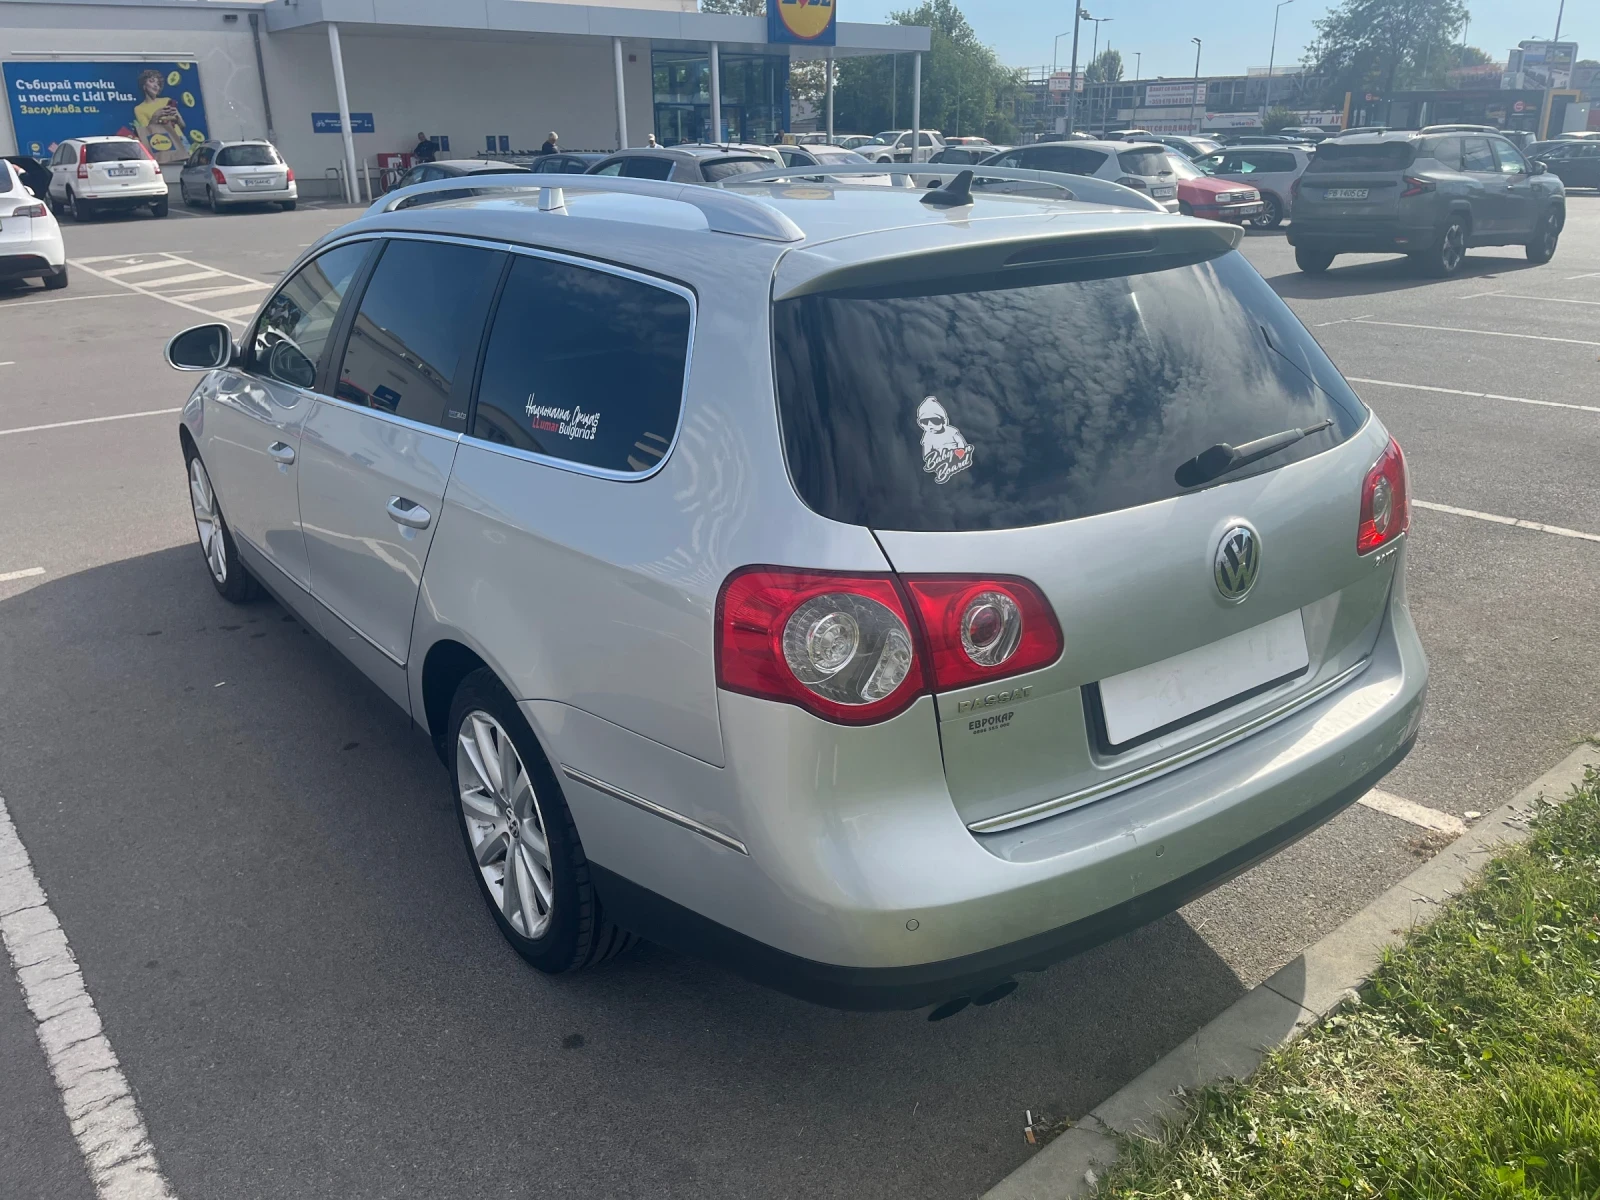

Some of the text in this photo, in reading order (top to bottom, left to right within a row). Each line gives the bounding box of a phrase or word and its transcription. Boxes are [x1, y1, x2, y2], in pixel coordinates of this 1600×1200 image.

[16, 79, 115, 91] Събирай точки
[18, 91, 137, 102] и пести с Lidl Plus.
[20, 104, 100, 115] Заслужава си.
[532, 416, 591, 440] LLumar Bulgaria
[924, 447, 955, 471] Baby
[935, 453, 970, 481] Board
[1216, 528, 1258, 598] VW
[957, 685, 1034, 714] PASSAT
[968, 711, 1015, 731] ЕВРОКАР
